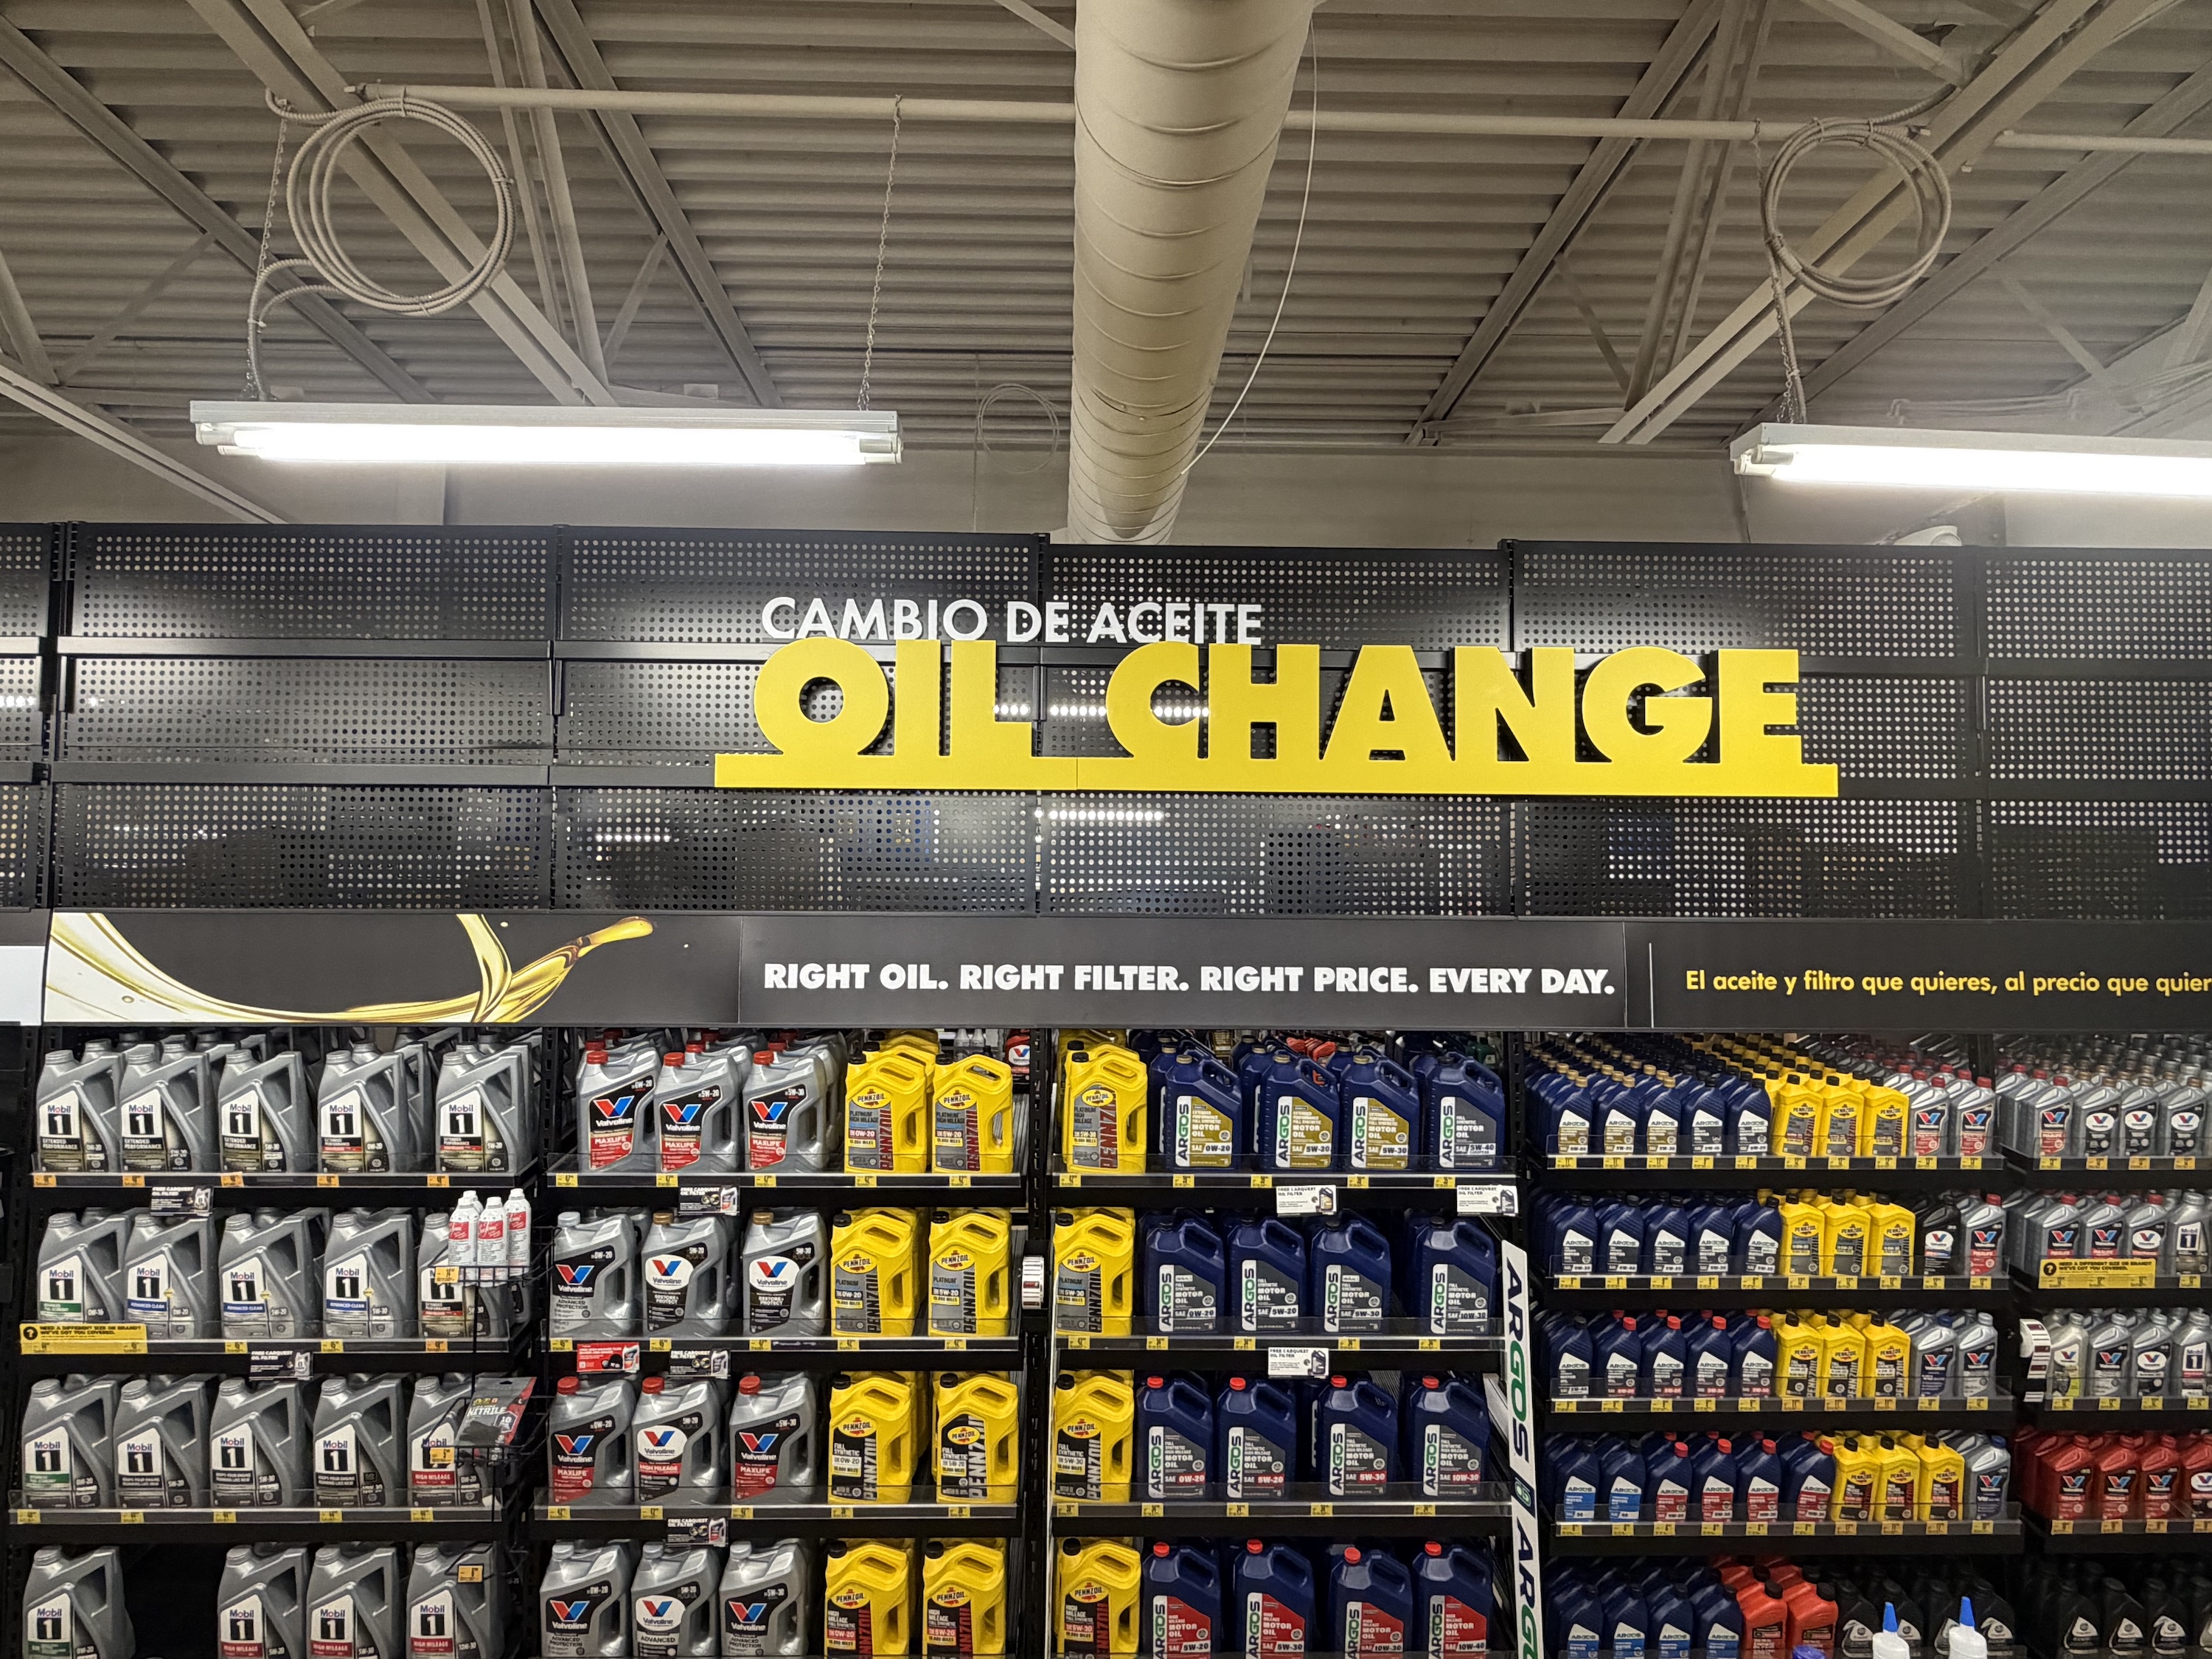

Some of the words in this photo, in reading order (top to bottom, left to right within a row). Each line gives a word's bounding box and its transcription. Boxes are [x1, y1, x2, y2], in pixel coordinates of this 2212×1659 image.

[762, 597, 988, 641] CAMBIO
[1007, 601, 1069, 642] DE
[1086, 602, 1262, 645] ACEITE
[754, 637, 1032, 757] OIL
[1106, 641, 1802, 765] CHANGE
[765, 963, 869, 989] RIGHT
[880, 964, 948, 990] OIL.
[960, 964, 1063, 990] RIGHT
[1075, 965, 1189, 991] FILTER.
[1201, 967, 1303, 991] RIGHT
[1315, 967, 1419, 992] PRICE.
[1430, 968, 1532, 992] EVERY
[1542, 969, 1615, 994] DAY.
[1687, 970, 1705, 990] El
[1714, 970, 1777, 991] aceite
[1784, 977, 1797, 995] y
[1804, 970, 1854, 991] filtro
[1862, 977, 1903, 995] que
[1911, 971, 1997, 996] quieres,
[2005, 971, 2025, 991] al
[2034, 972, 2099, 996] precio
[2107, 978, 2149, 996] que
[858, 1094, 886, 1102] PENNZOIL
[944, 1095, 971, 1103] PENNZOIL
[1086, 1093, 1109, 1102] PENNZOIL
[47, 1105, 72, 1113] Mobil
[129, 1105, 153, 1113] Mobil
[230, 1104, 251, 1113] Mobil
[330, 1105, 353, 1113] Mobil
[449, 1105, 473, 1113] Mobil
[596, 1116, 633, 1127] Valvoline
[753, 1121, 787, 1130] Valvoline
[665, 1123, 700, 1132] Valvoline
[1178, 1103, 1189, 1161] ARGOS
[1192, 1124, 1220, 1132] MOTOR
[1279, 1105, 1290, 1162] ARGOS
[1355, 1105, 1366, 1162] ARGOS
[1442, 1105, 1453, 1162] ARGOS
[594, 1135, 626, 1144] MAXLIFE
[942, 1255, 970, 1264] PENNZOIL
[1068, 1257, 1095, 1265] PENNZOIL
[49, 1269, 74, 1278] Mobil
[136, 1267, 160, 1277] Mobil
[230, 1271, 254, 1280] Mobil
[335, 1267, 359, 1276] Mobil
[653, 1277, 682, 1285] Valvoline
[757, 1279, 787, 1287] Valvoline
[558, 1284, 592, 1293] Valvoline
[1161, 1272, 1172, 1326] ARGOS
[1244, 1267, 1255, 1326] ARGOS
[1327, 1272, 1338, 1327] ARGOS
[1433, 1272, 1445, 1328] ARGOS
[1507, 1256, 1529, 1464] ARGOS
[467, 1407, 507, 1416] NITRILE
[844, 1422, 872, 1430] PENNZOIL
[952, 1431, 975, 1439] PENNZOIL
[35, 1441, 60, 1450] Mobil
[221, 1437, 245, 1446] Mobil
[323, 1440, 348, 1448] Mobil
[127, 1443, 153, 1452] Mobil
[644, 1447, 675, 1455] Valvoline
[557, 1454, 594, 1463] Valvoline
[741, 1453, 776, 1461] Valvoline
[1332, 1432, 1343, 1489] ARGOS
[1426, 1432, 1438, 1490] ARGOS
[1151, 1434, 1162, 1492] ARGOS
[1230, 1435, 1241, 1492] ARGOS
[1074, 1586, 1103, 1596] PENNZOIL
[836, 1593, 865, 1603] PENNZOIL
[937, 1591, 965, 1601] PENNZOIL
[38, 1608, 62, 1617] Mobil
[420, 1604, 445, 1613] Mobil
[230, 1609, 254, 1618] Mobil
[321, 1609, 345, 1618] Mobil
[552, 1621, 588, 1630] Valvoline
[643, 1618, 673, 1626] Valvoline
[731, 1622, 766, 1631] Valvoline
